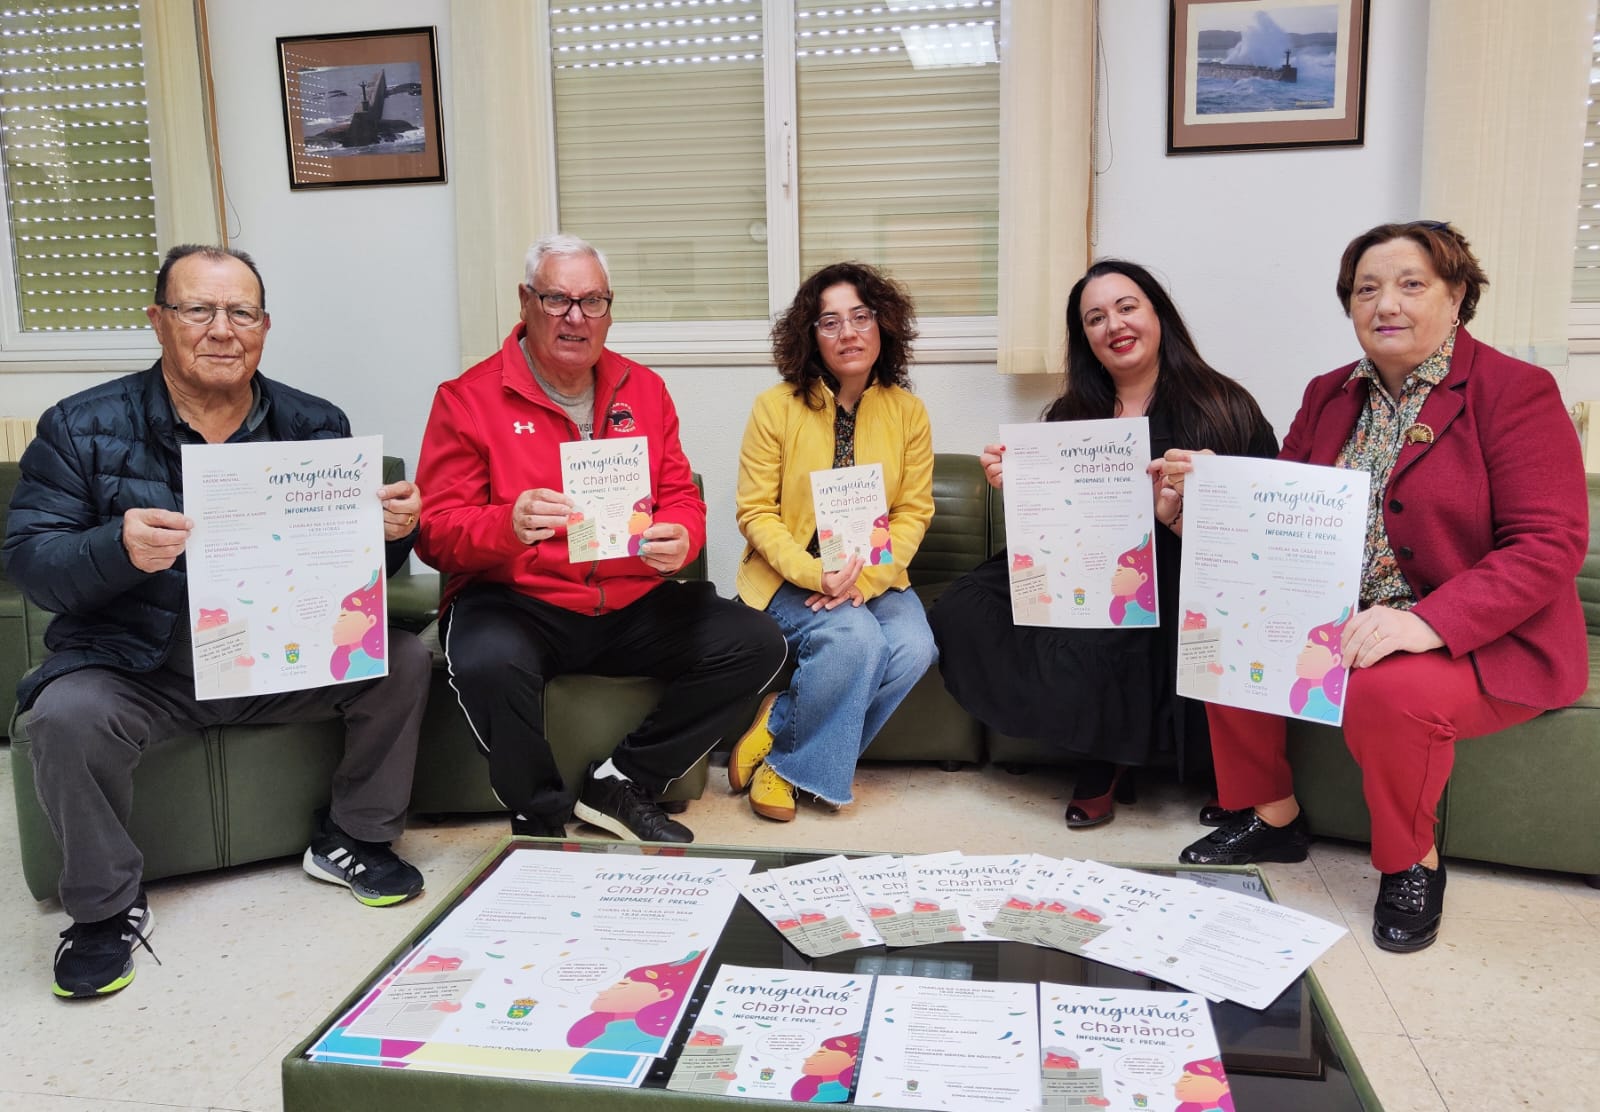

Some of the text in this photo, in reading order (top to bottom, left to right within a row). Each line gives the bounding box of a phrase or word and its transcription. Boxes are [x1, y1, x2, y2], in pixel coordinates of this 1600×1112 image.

[1061, 441, 1133, 462] arruguiñas
[269, 464, 363, 488] arruguiñas
[1254, 490, 1347, 511] arruguiñas
[595, 871, 714, 885] arruguiñas
[918, 865, 1023, 878] arruguiñas
[726, 983, 852, 1002] arruguiñas
[732, 1013, 779, 1022] INFORMARSE
[1056, 1001, 1193, 1023] arruguiñas
[1076, 1033, 1126, 1044] INFORMARSE
